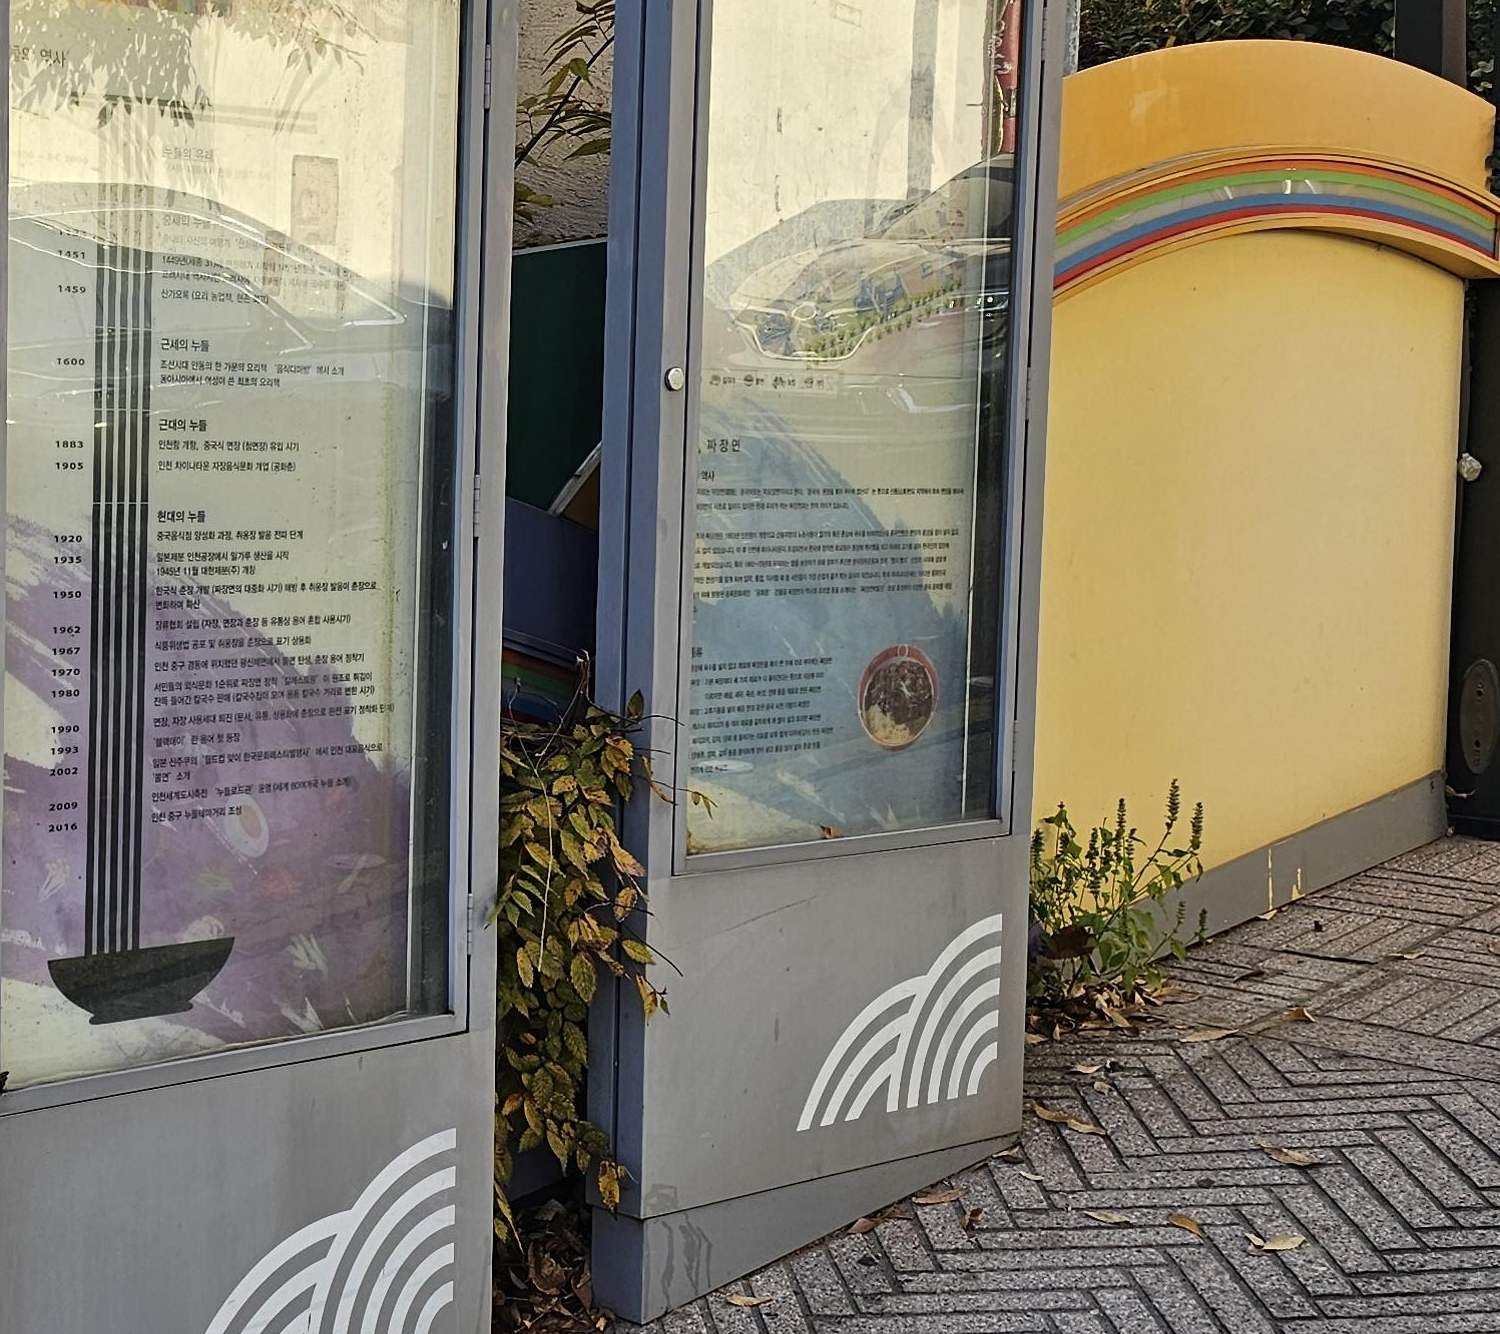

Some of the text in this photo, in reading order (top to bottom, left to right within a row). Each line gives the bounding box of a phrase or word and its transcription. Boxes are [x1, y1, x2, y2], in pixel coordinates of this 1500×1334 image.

[57, 284, 86, 294] 1459
[160, 337, 209, 352] 근세의 누들
[56, 357, 85, 366] 1600
[158, 418, 207, 432] 근대의 누들
[55, 440, 83, 448] 1883
[55, 461, 83, 470] 1905
[157, 510, 205, 523] 현대의 누들
[53, 534, 82, 543] 1920
[53, 555, 81, 564] 1935
[53, 590, 81, 599] 1950
[53, 624, 81, 633] 1962
[51, 646, 80, 656] 1967
[51, 668, 80, 677] 1970
[51, 689, 80, 698] 1980
[51, 724, 79, 734] 1990
[50, 746, 78, 755] 1993
[49, 766, 78, 777] 2002
[48, 801, 78, 811] 2009
[48, 822, 77, 833] 2016
